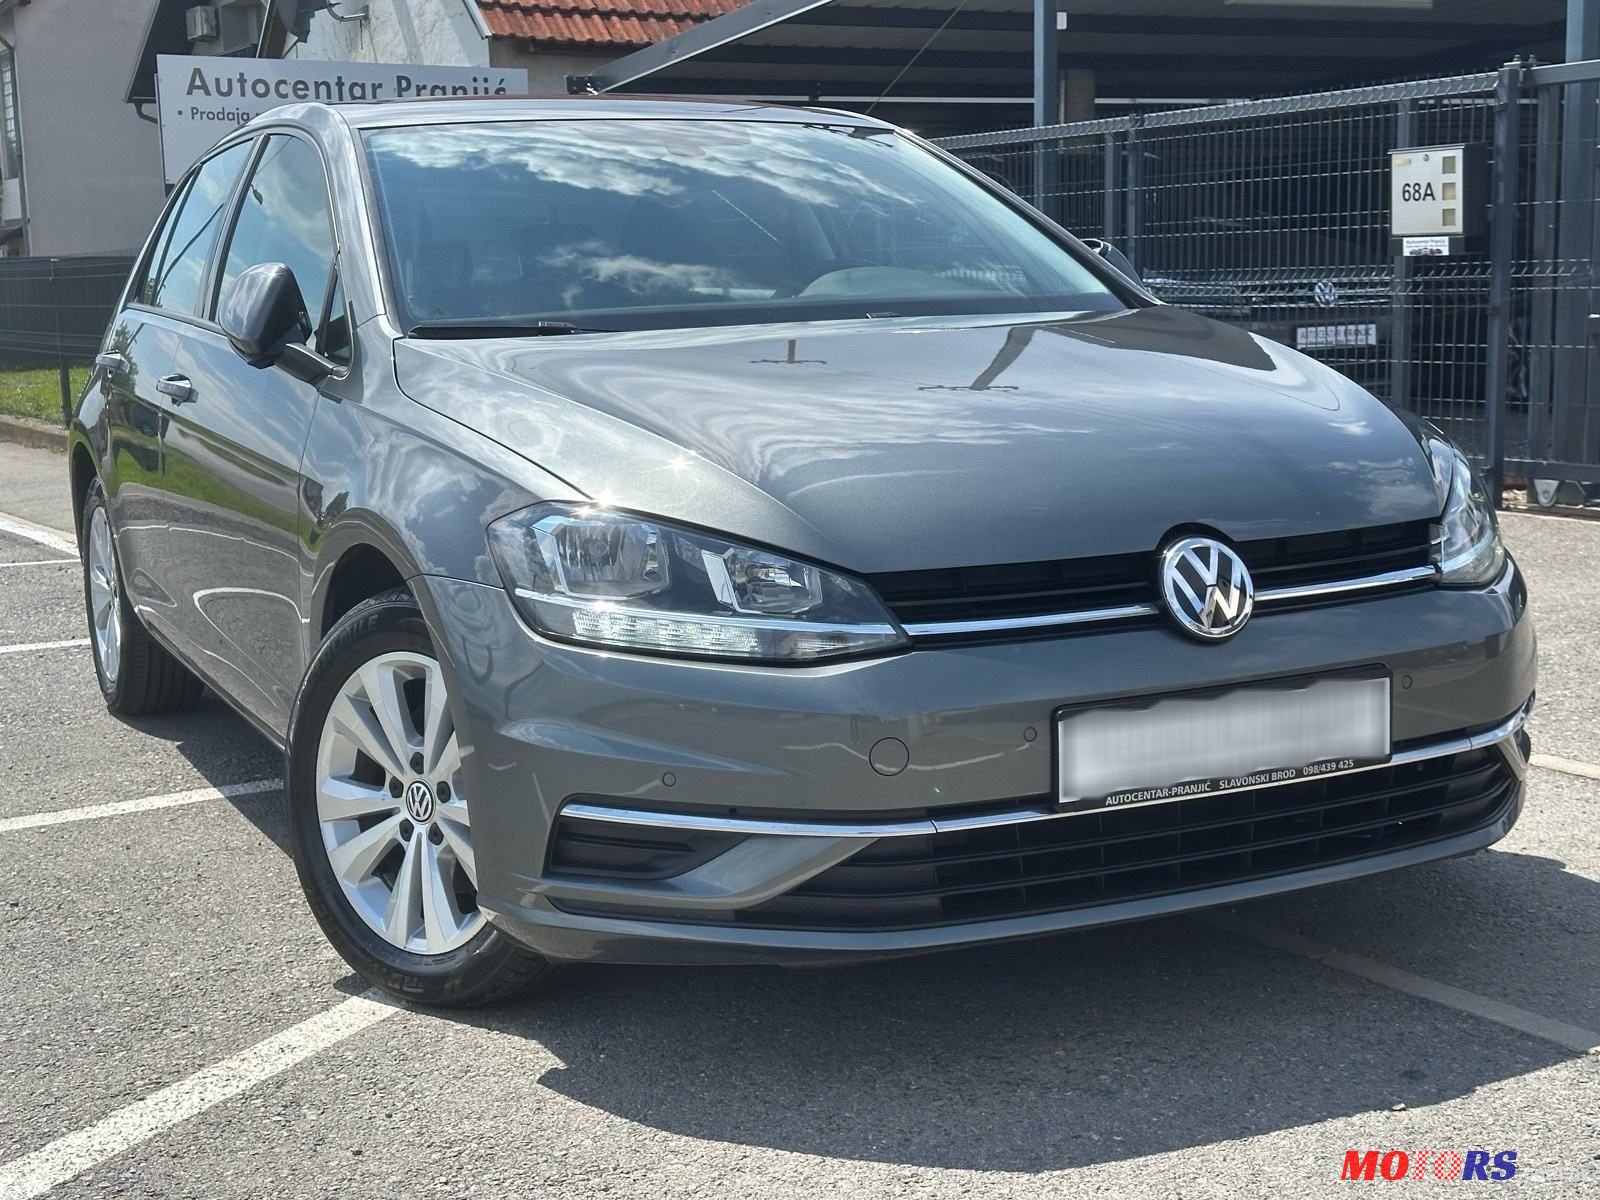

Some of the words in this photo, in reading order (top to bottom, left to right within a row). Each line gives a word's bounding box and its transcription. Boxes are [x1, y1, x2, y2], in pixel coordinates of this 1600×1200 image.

[186, 67, 383, 102] Autocentar
[190, 106, 250, 125] Prodaja
[1402, 182, 1436, 202] 68A
[1105, 780, 1211, 806] AUTOCENTAR-PRANJIĆ
[1219, 773, 1270, 790] SLAVONSKI
[1271, 768, 1296, 781] BROD
[1303, 761, 1336, 776] 098/439
[1338, 759, 1354, 769] 425
